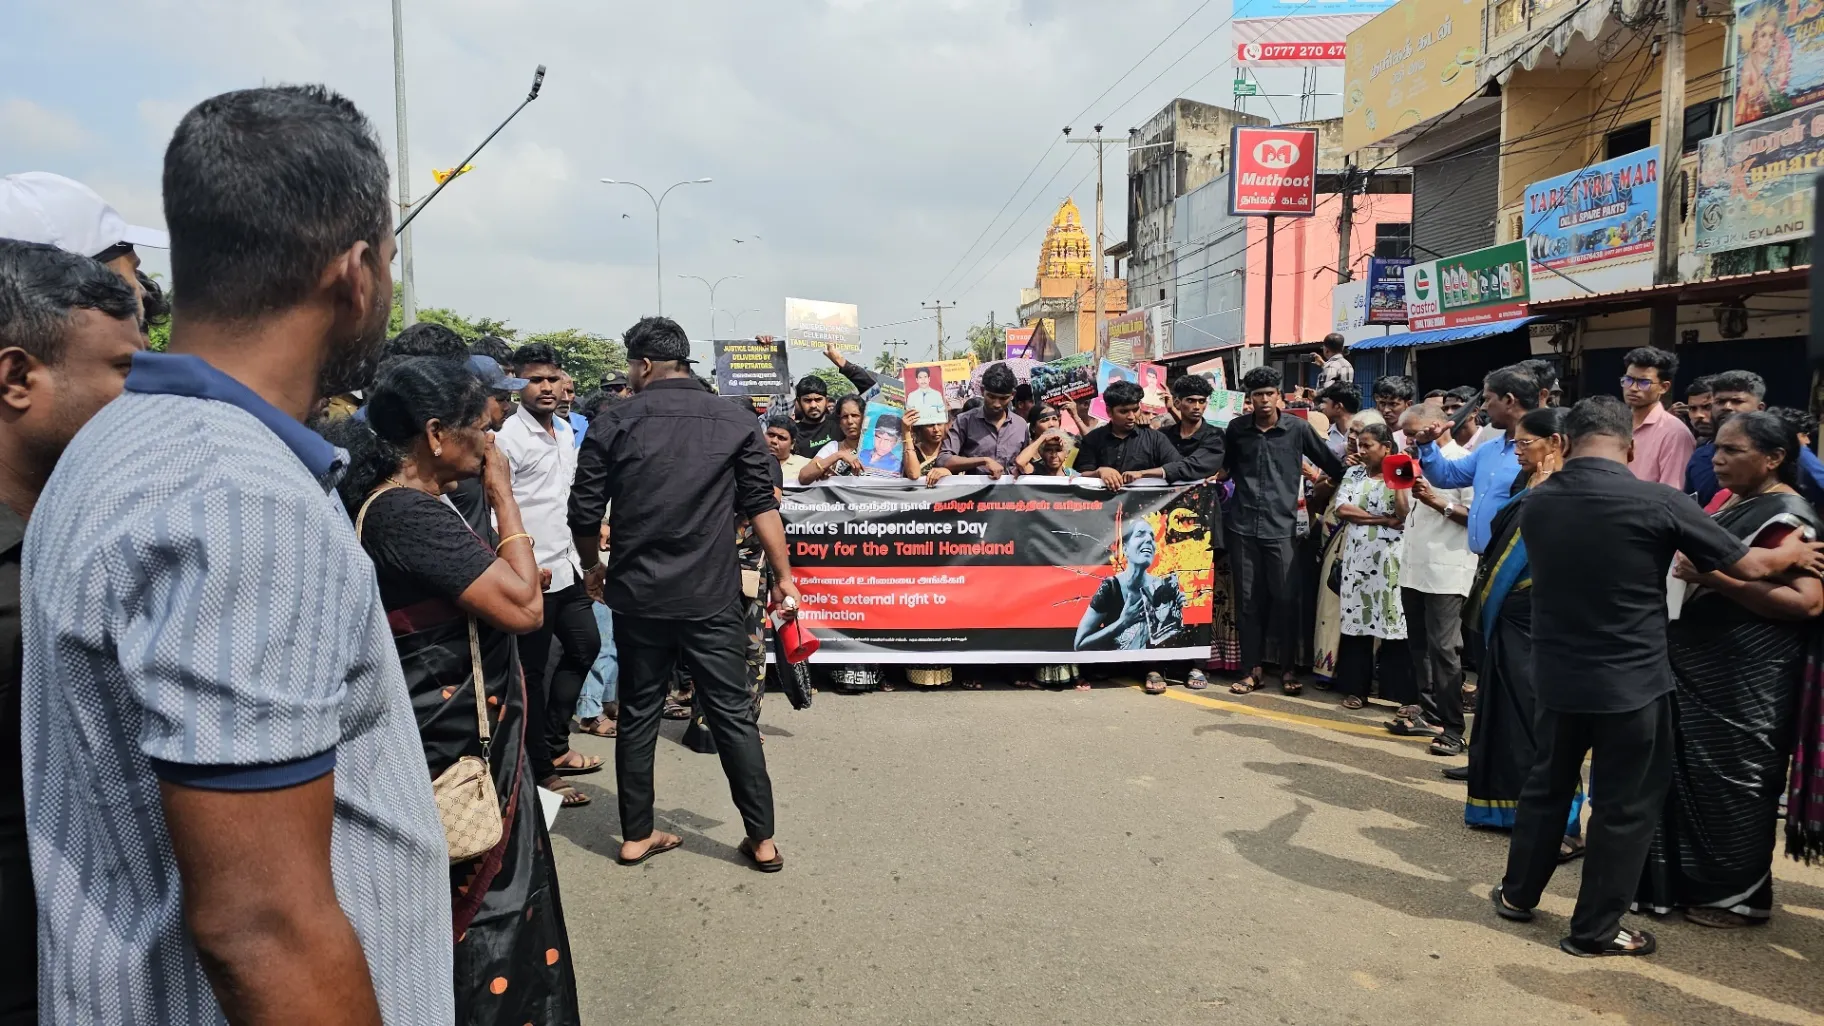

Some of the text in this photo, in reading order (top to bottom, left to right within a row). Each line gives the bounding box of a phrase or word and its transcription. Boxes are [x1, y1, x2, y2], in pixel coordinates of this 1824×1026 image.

[1264, 46, 1295, 57] 0777
[1300, 46, 1324, 56] 270
[1241, 172, 1310, 187] Muthoot
[1570, 171, 1613, 202] TYRE
[1240, 191, 1308, 206] தங்கக் கடன்
[1579, 210, 1601, 222] SPARE
[1602, 202, 1626, 216] PARTS
[1741, 220, 1805, 240] LEYLAND
[1411, 300, 1438, 315] Castrol
[901, 500, 931, 513] நாள்
[933, 500, 974, 513] தமிழர்
[784, 520, 988, 538] anka's Independence Day
[797, 542, 829, 559] Day
[834, 541, 857, 556] for
[862, 541, 889, 556] the
[894, 541, 934, 556] Tamil
[939, 540, 1015, 556] Homeland
[801, 592, 946, 608] ople's external right to
[797, 608, 865, 621] ermination
